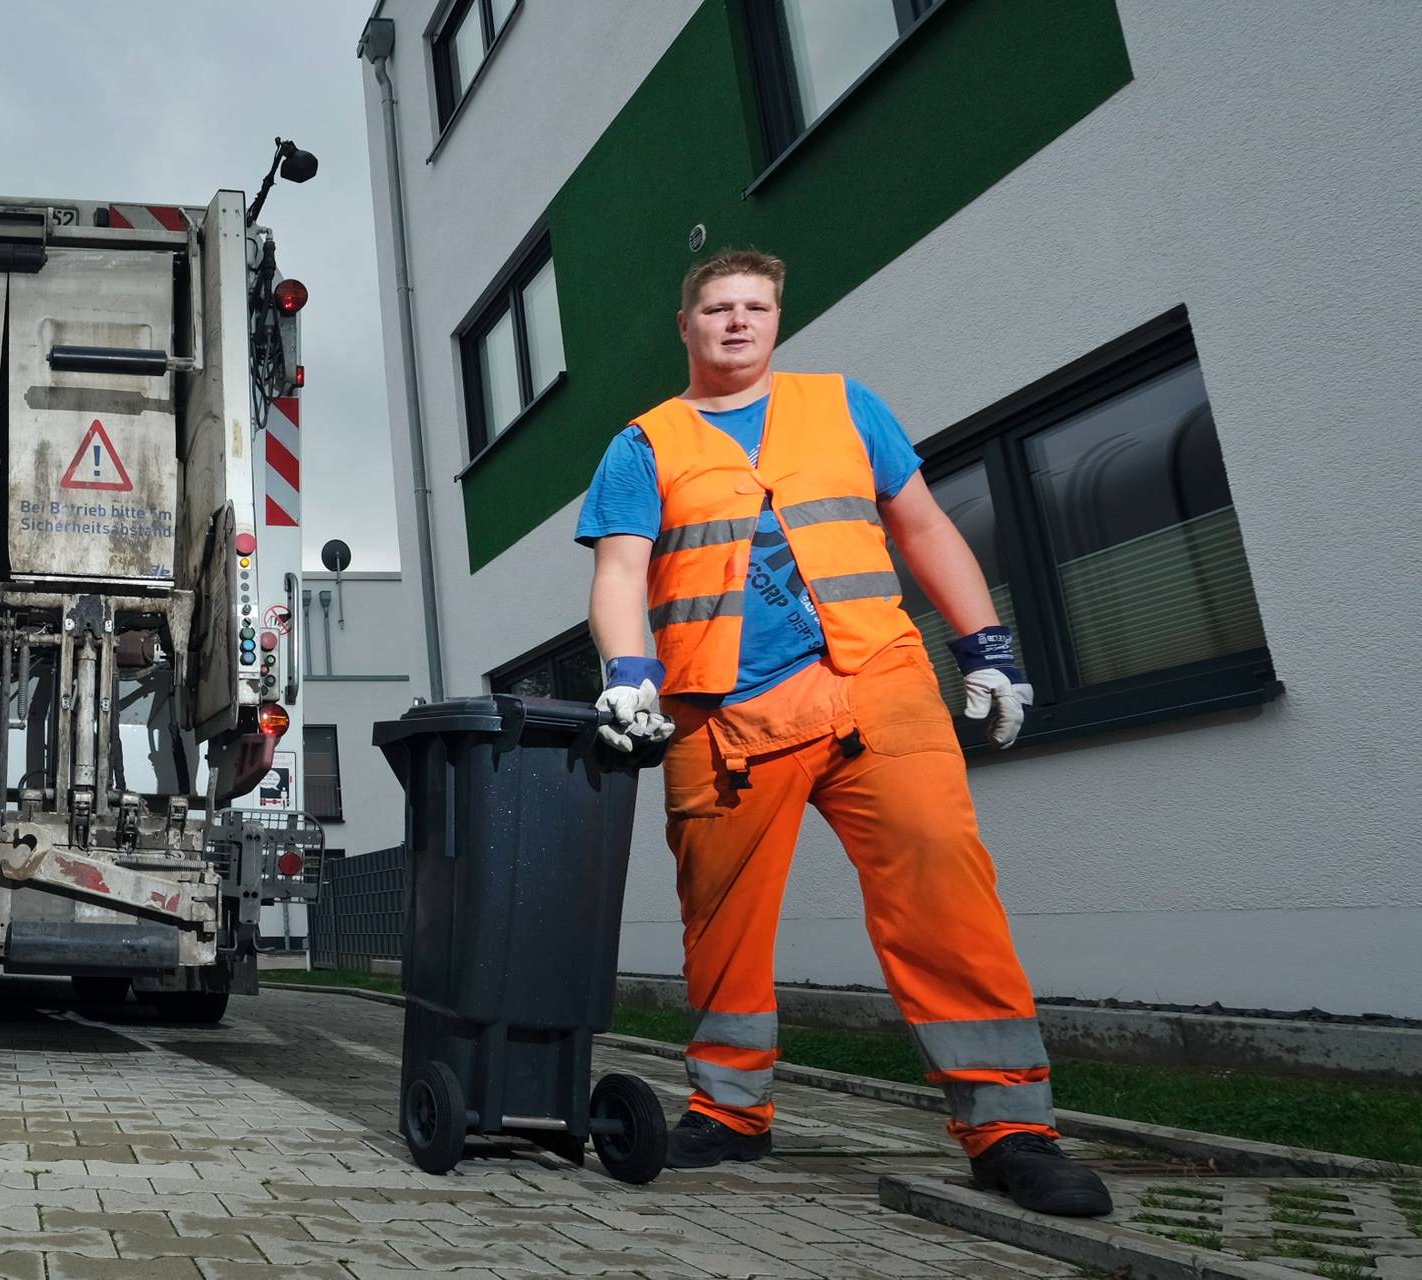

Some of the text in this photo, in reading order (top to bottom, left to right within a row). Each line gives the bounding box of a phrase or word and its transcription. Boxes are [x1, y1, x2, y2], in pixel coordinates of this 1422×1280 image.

[20, 500, 45, 514] Bei
[111, 505, 146, 519] bitte
[20, 517, 172, 538] Sicherheitsabstand
[786, 611, 816, 640] DEPT
